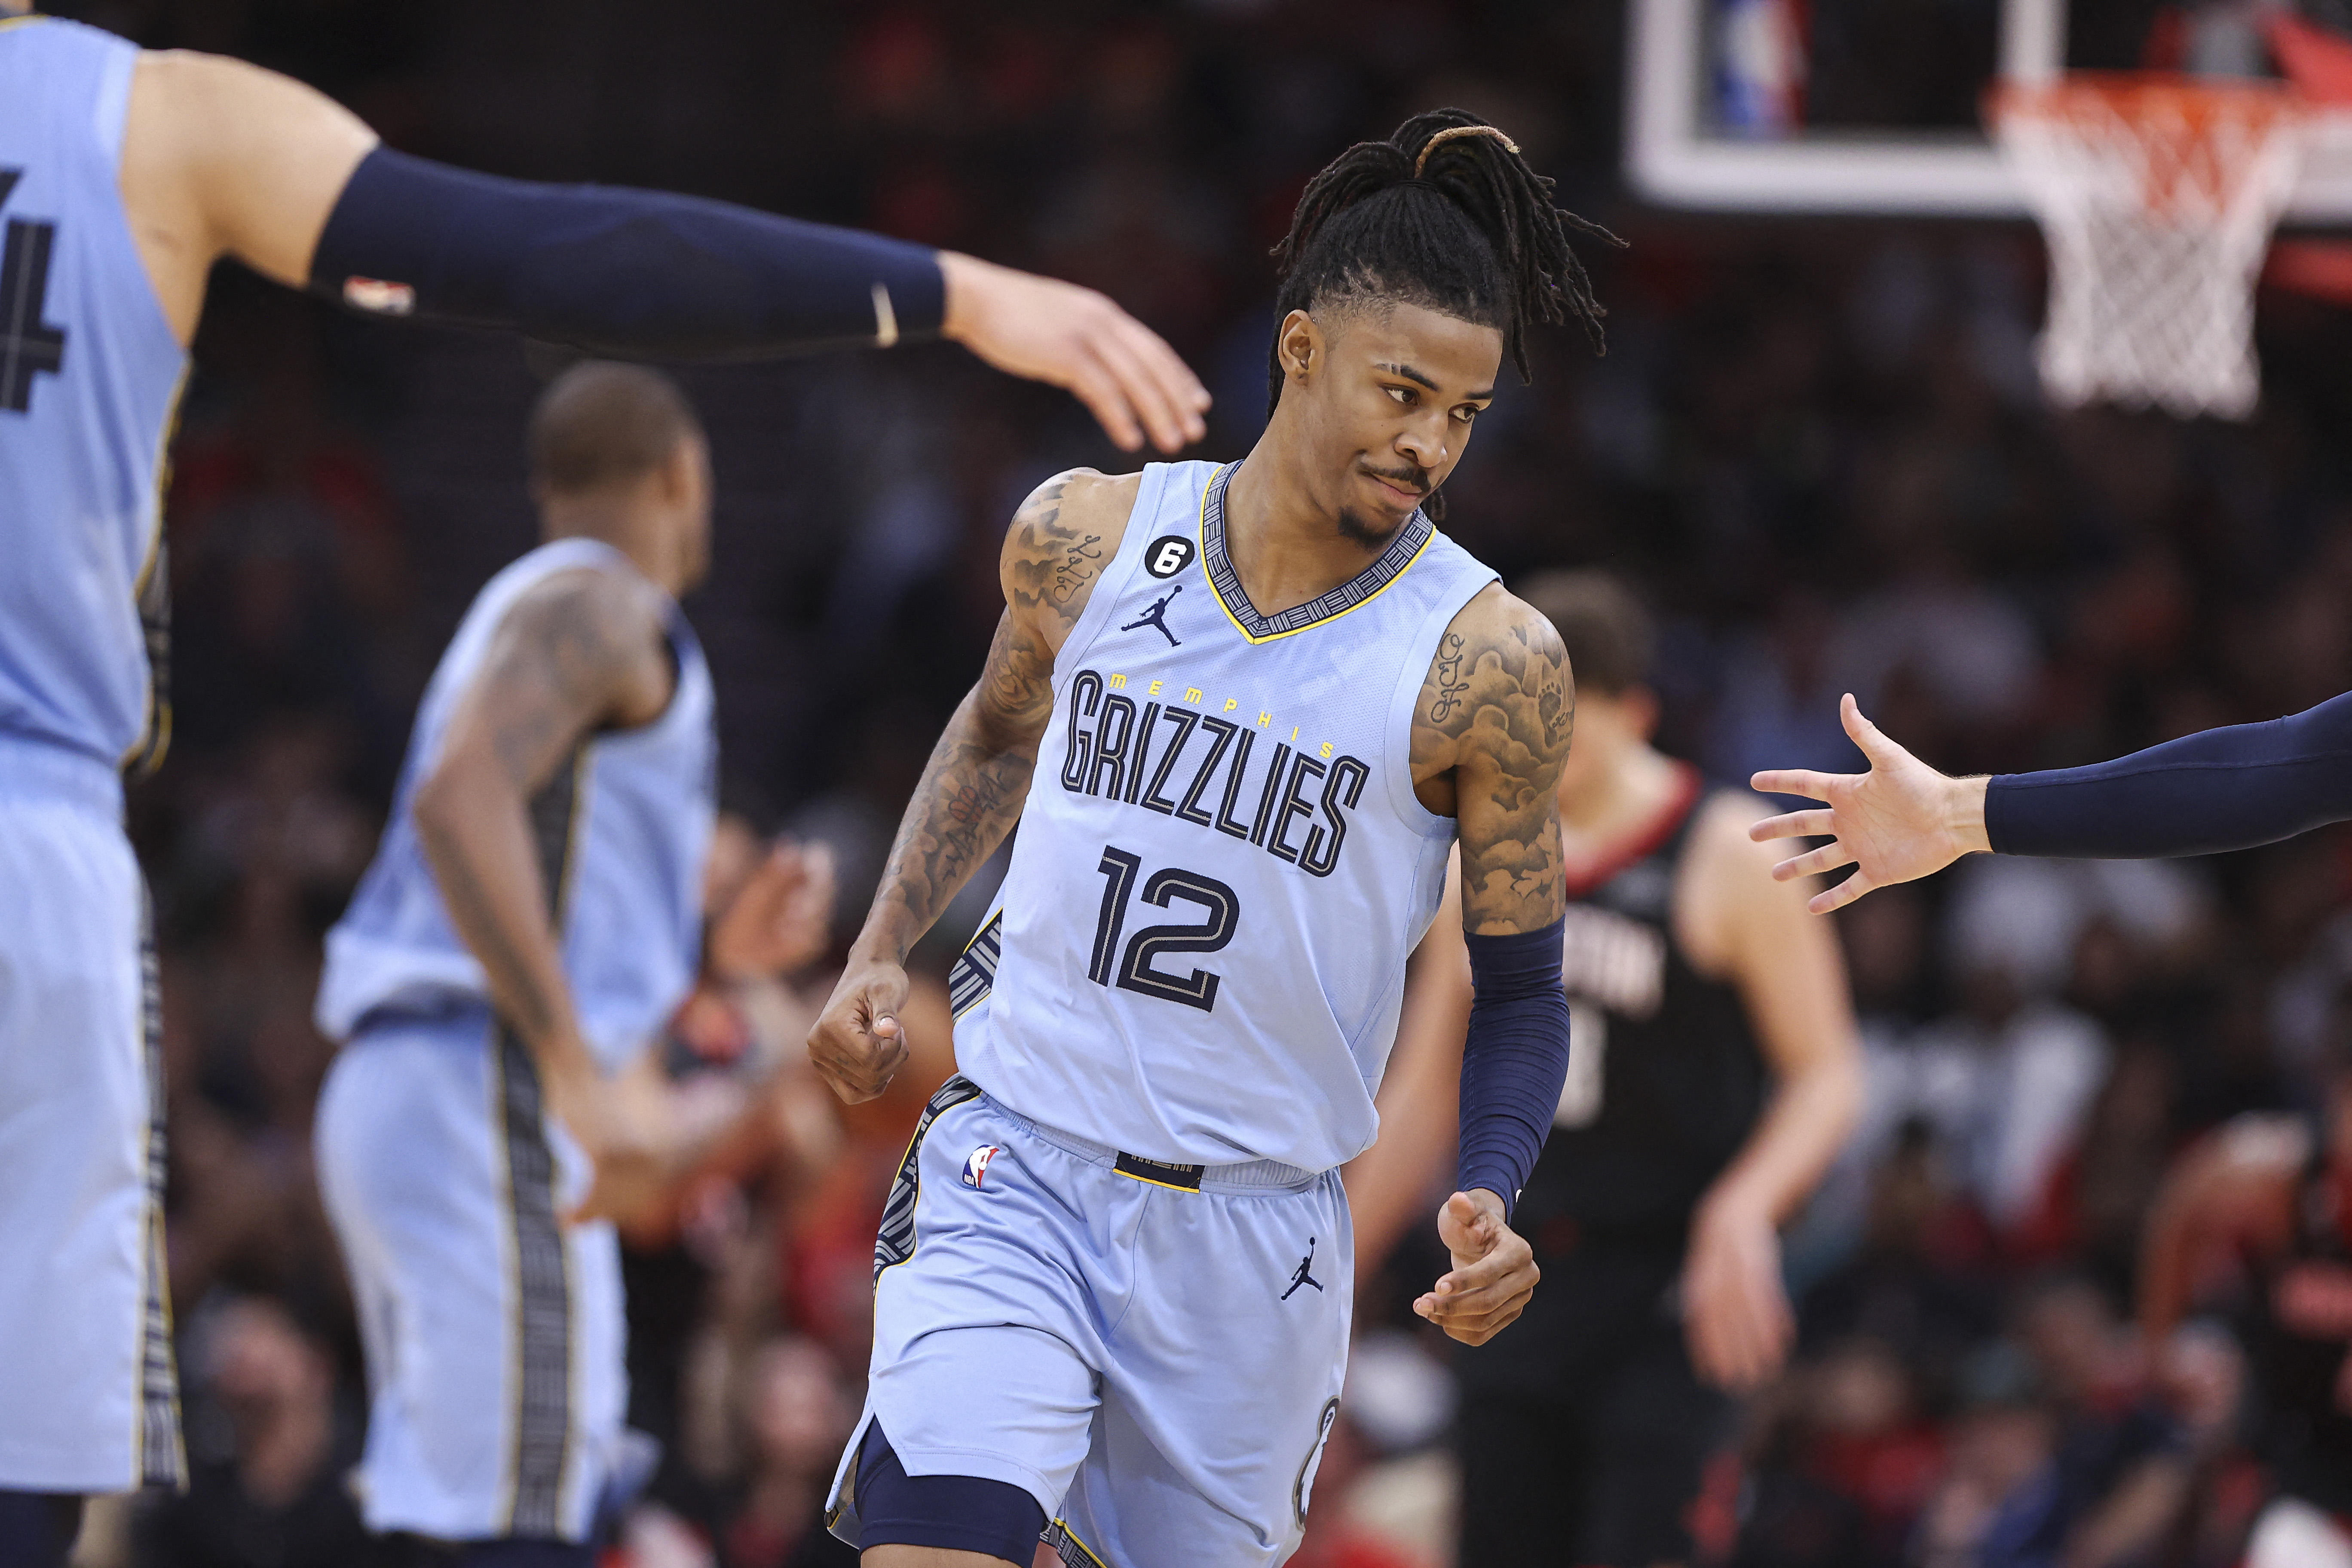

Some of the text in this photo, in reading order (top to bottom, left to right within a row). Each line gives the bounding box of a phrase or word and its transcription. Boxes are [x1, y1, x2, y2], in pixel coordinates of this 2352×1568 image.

[1154, 541, 1187, 574] 6
[1110, 673, 1334, 759] MEMPHIS
[1062, 671, 1370, 877] GRIZZLIES
[1088, 845, 1240, 1013] 12
[964, 1174, 974, 1185] NBA
